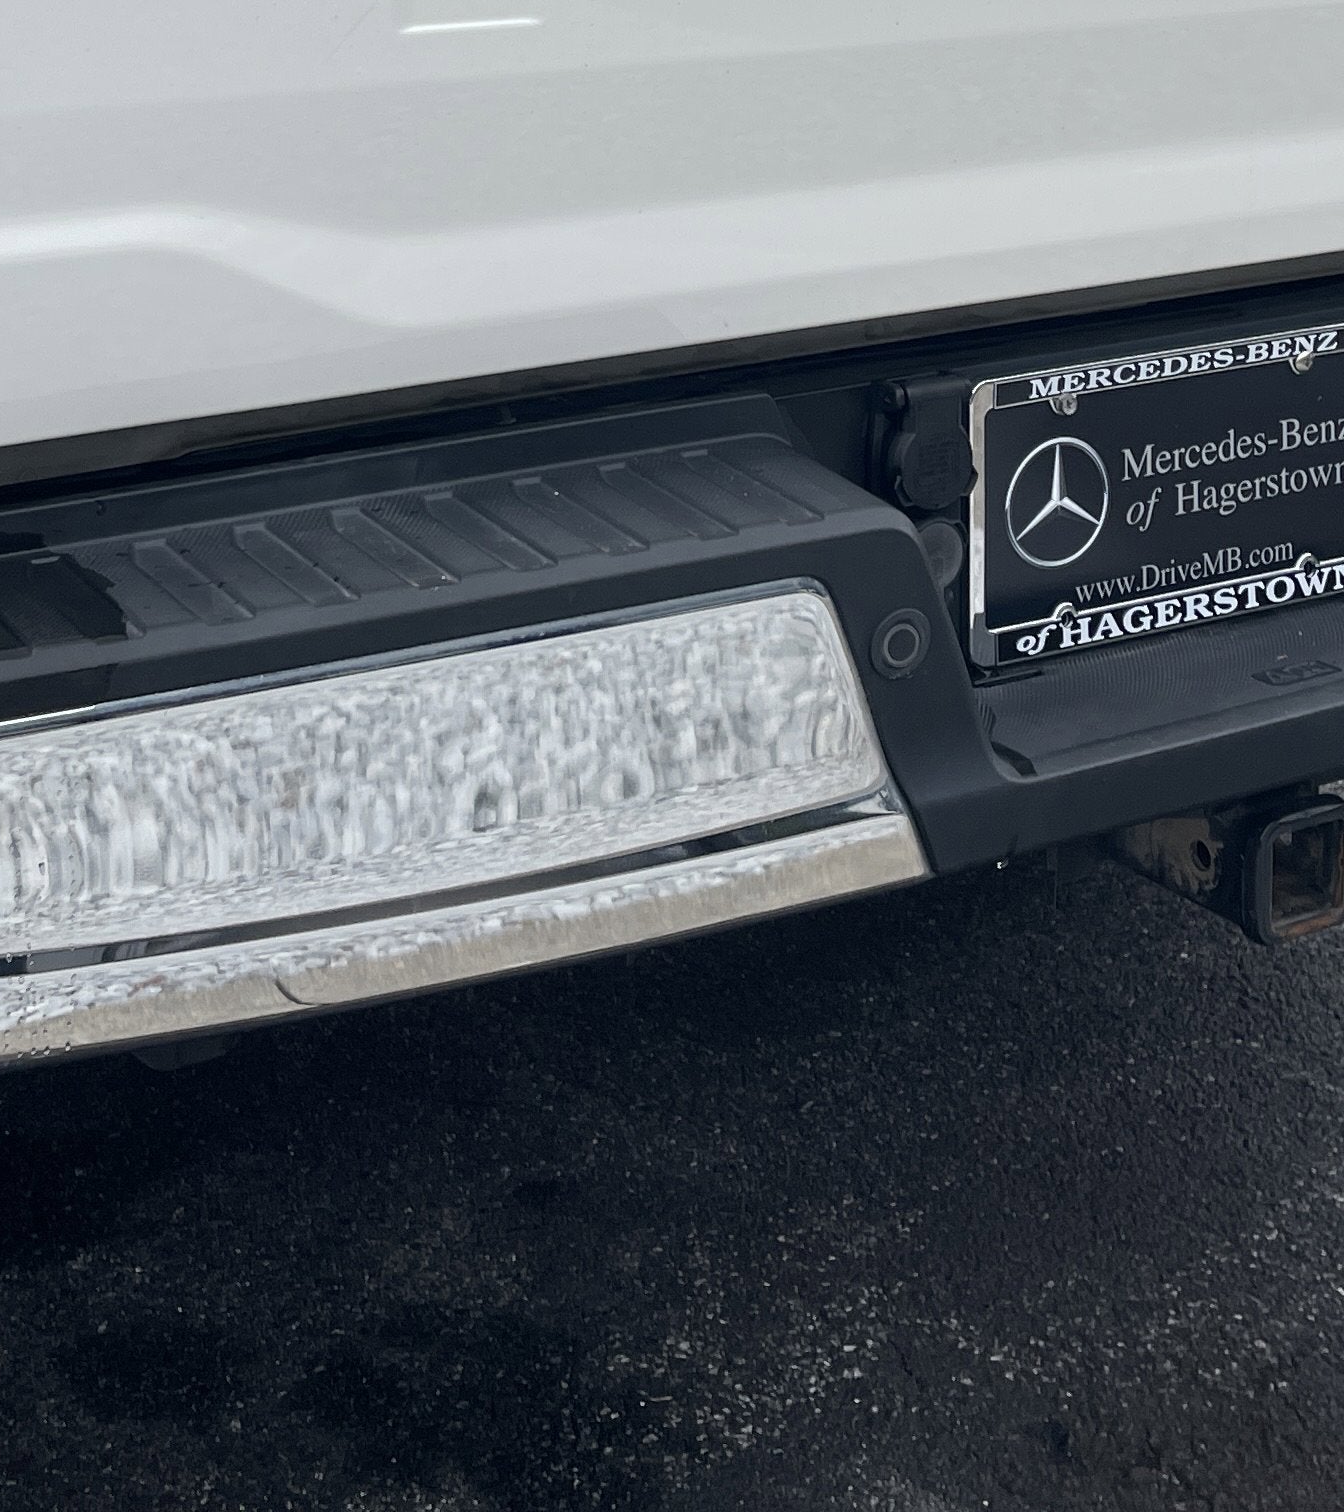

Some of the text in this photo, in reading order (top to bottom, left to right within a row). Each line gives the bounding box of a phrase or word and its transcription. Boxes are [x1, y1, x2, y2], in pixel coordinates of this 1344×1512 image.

[1028, 330, 1339, 399] MERCEDES-BENZ
[1126, 488, 1162, 531] of
[1075, 542, 1295, 603] www.DriveMB.com
[1016, 624, 1055, 656] of
